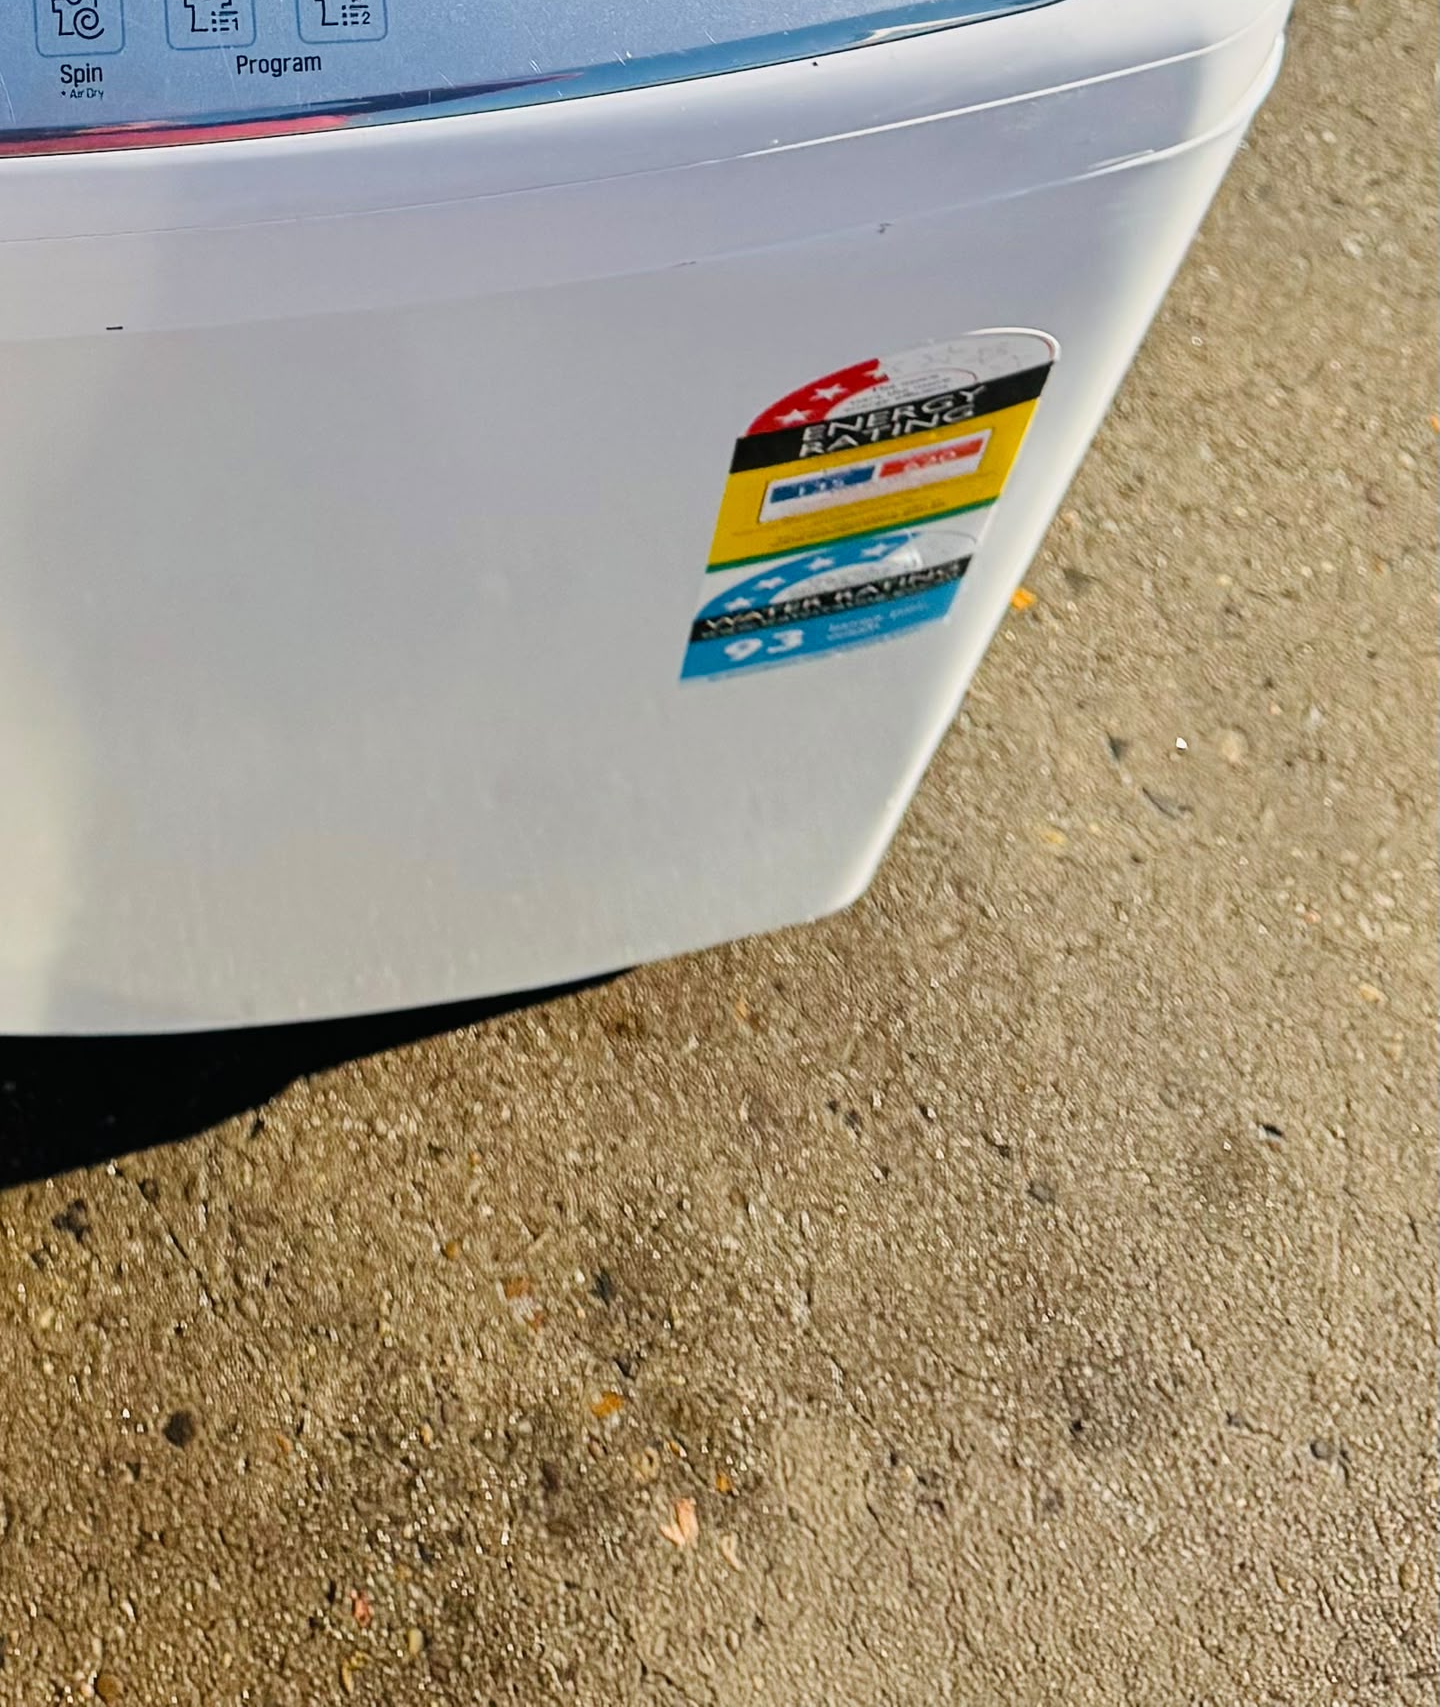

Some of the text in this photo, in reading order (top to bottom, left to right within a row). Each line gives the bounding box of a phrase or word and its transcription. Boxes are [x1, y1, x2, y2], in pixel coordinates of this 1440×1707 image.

[60, 63, 103, 87] Spin
[236, 55, 322, 78] Program
[87, 88, 104, 99] Dry
[802, 385, 986, 443] ENERGY
[799, 403, 975, 458] RATING
[706, 591, 822, 630] WATER
[834, 562, 969, 603] RATING
[724, 629, 804, 661] 93
